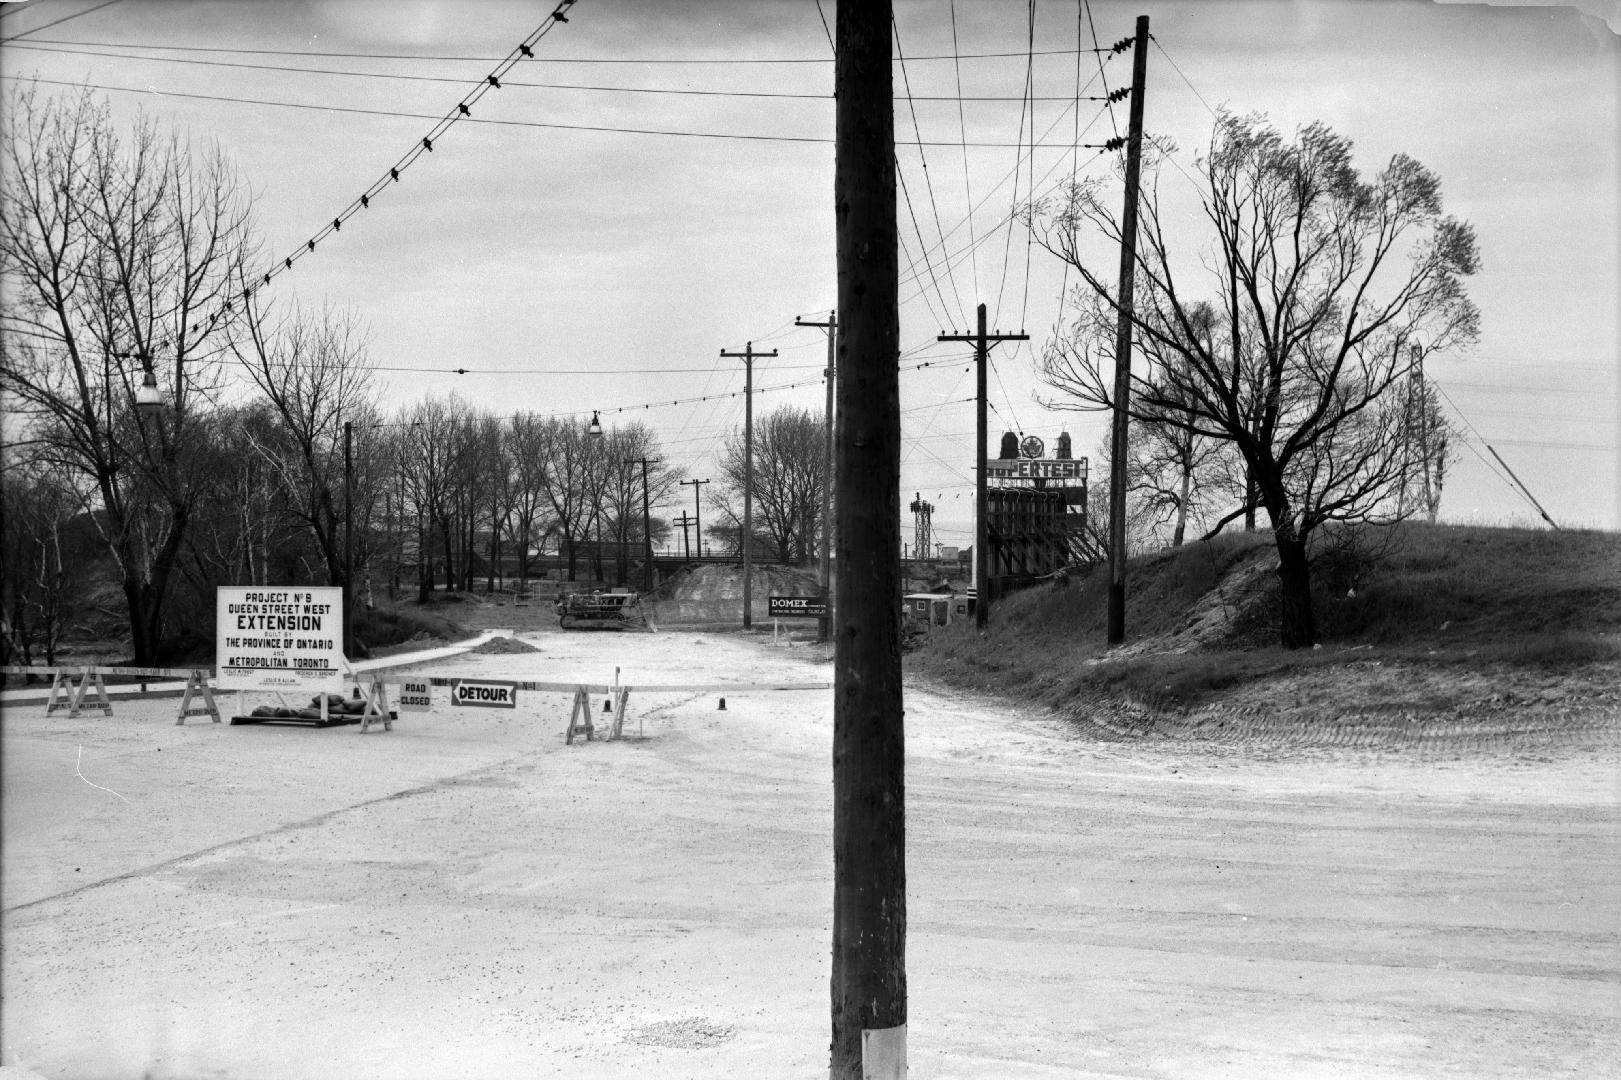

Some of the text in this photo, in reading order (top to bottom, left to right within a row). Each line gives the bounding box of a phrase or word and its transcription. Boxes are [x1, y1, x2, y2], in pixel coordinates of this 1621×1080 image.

[245, 592, 289, 603] PROJECT
[305, 593, 312, 603] 9
[771, 599, 808, 608] DOMEX
[228, 604, 331, 615] QUEEN STREET WEST
[237, 615, 322, 631] EXTENSION
[226, 638, 333, 650] THE PROVINCE OF ONTARIO
[228, 656, 329, 669] METROPOLITAN TORONTO
[405, 683, 426, 693] ROAD
[459, 686, 508, 702] DETOUR
[400, 696, 430, 706] CLOSED
